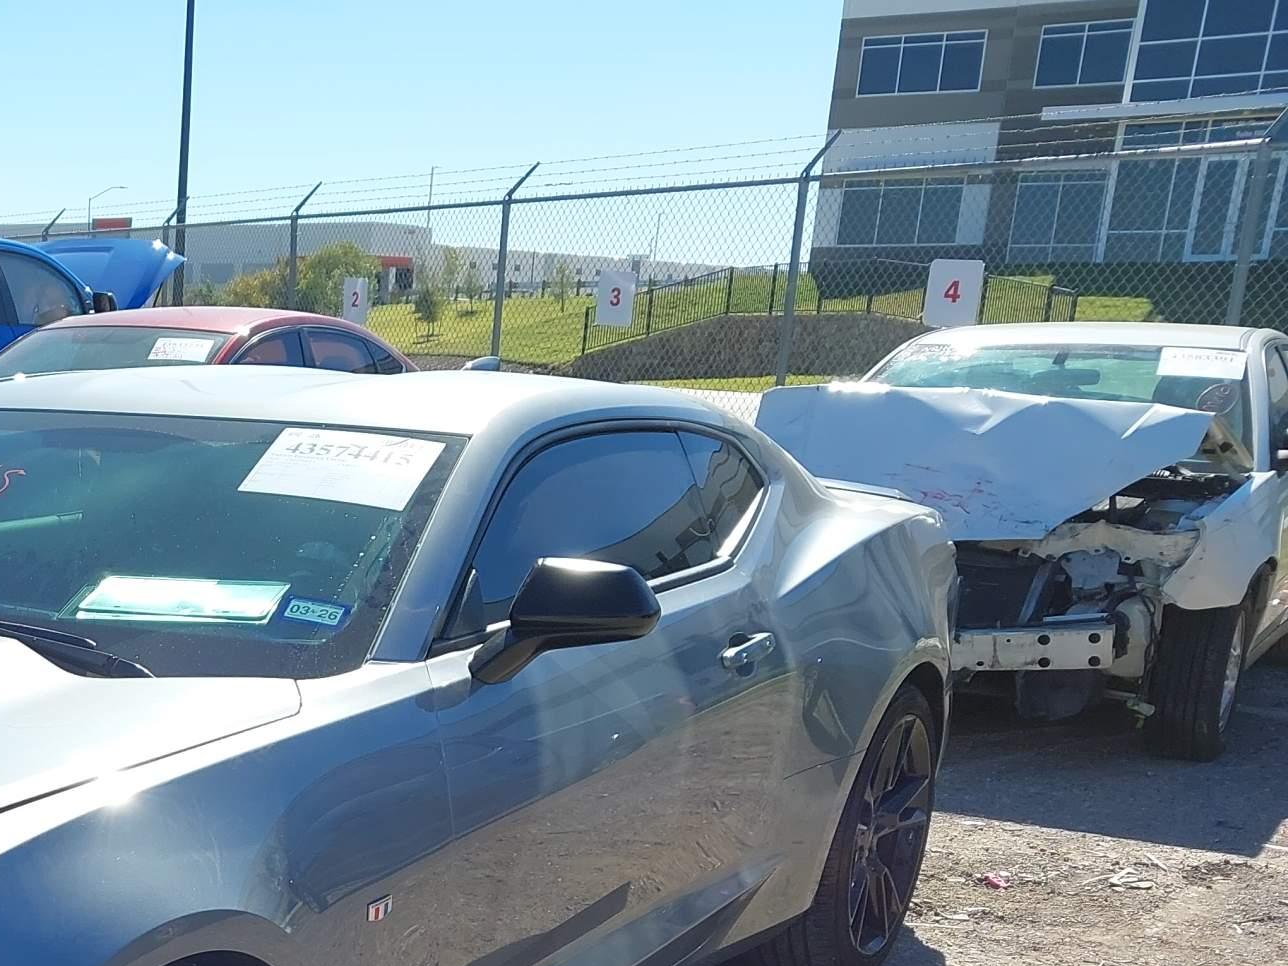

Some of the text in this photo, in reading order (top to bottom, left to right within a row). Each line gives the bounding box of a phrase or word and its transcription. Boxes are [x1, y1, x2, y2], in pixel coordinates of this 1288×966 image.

[352, 291, 360, 307] 2
[610, 287, 621, 307] 3
[944, 280, 961, 304] 4
[285, 441, 415, 465] 43574415
